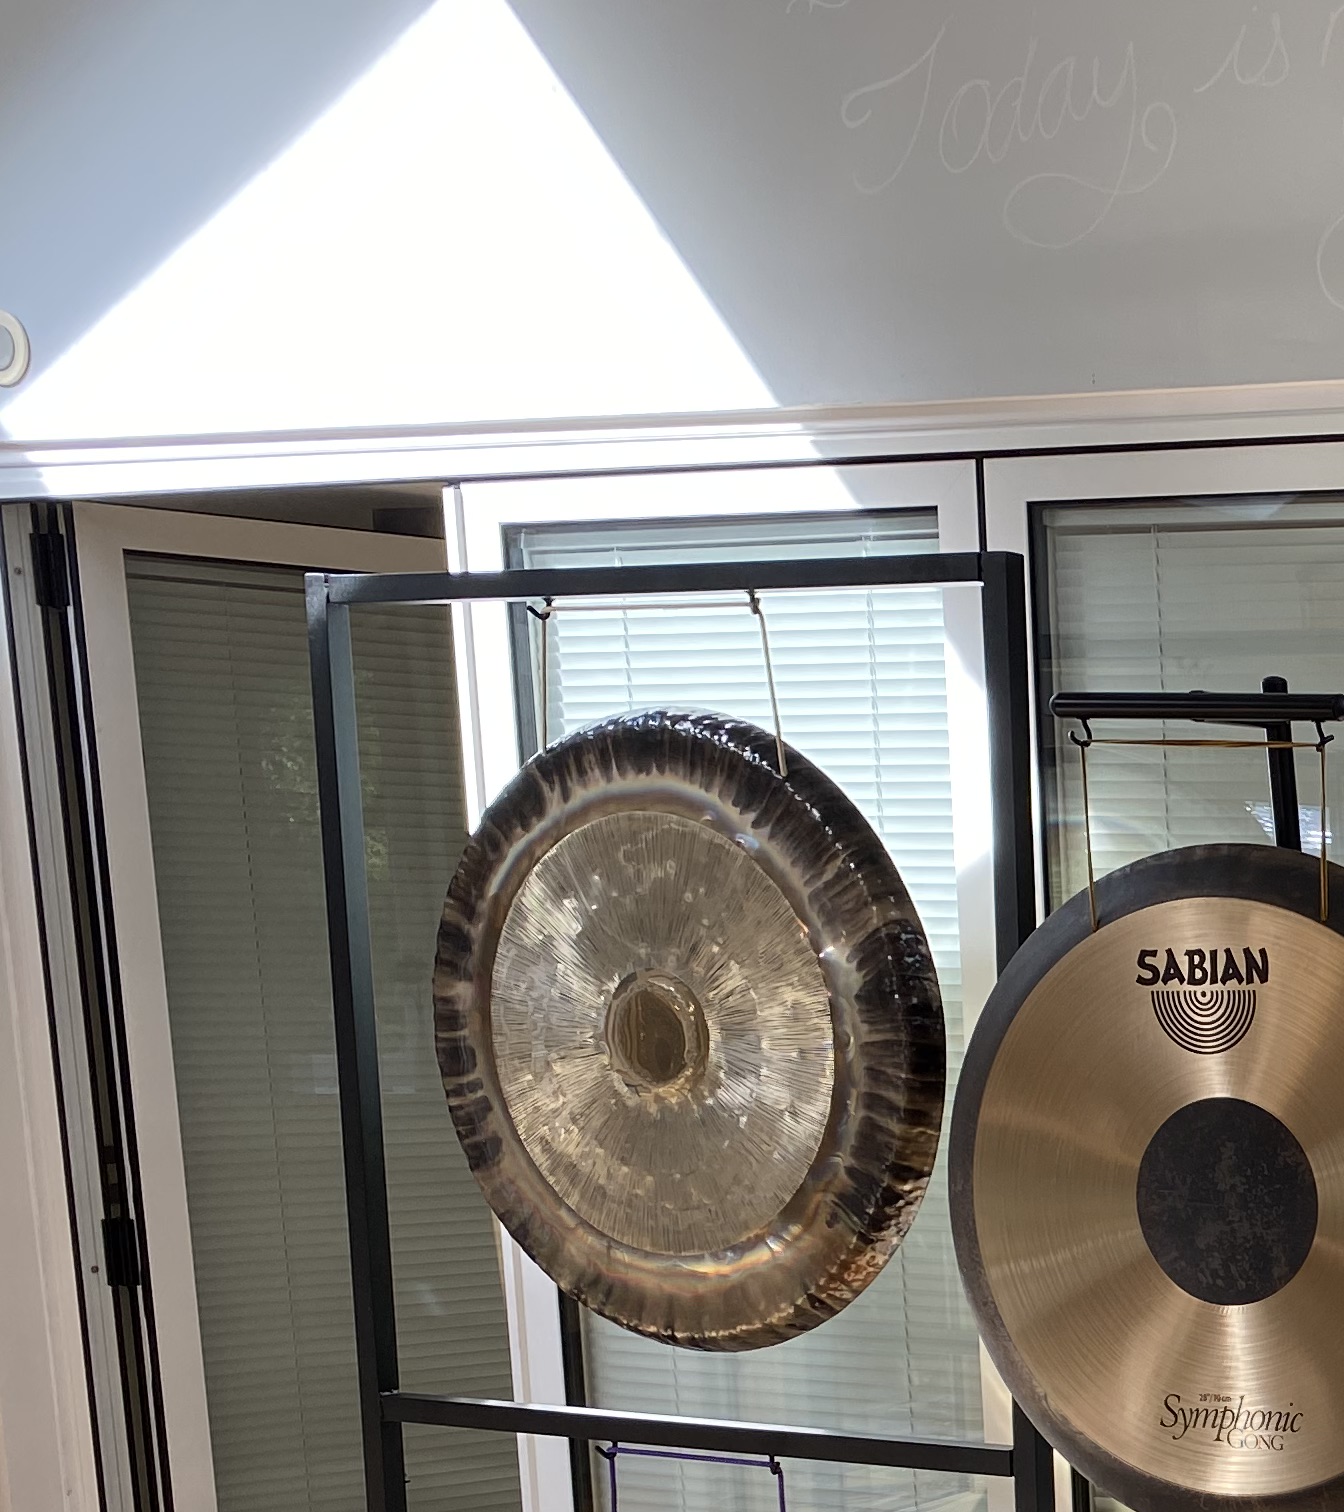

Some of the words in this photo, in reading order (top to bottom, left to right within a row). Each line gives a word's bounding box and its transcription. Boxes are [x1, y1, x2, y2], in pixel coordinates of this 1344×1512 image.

[840, 14, 1177, 249] Today
[1193, 4, 1290, 93] is
[1136, 946, 1269, 987] SABIAN
[1160, 1392, 1304, 1442] Symphonic
[1226, 1427, 1284, 1451] GONG
